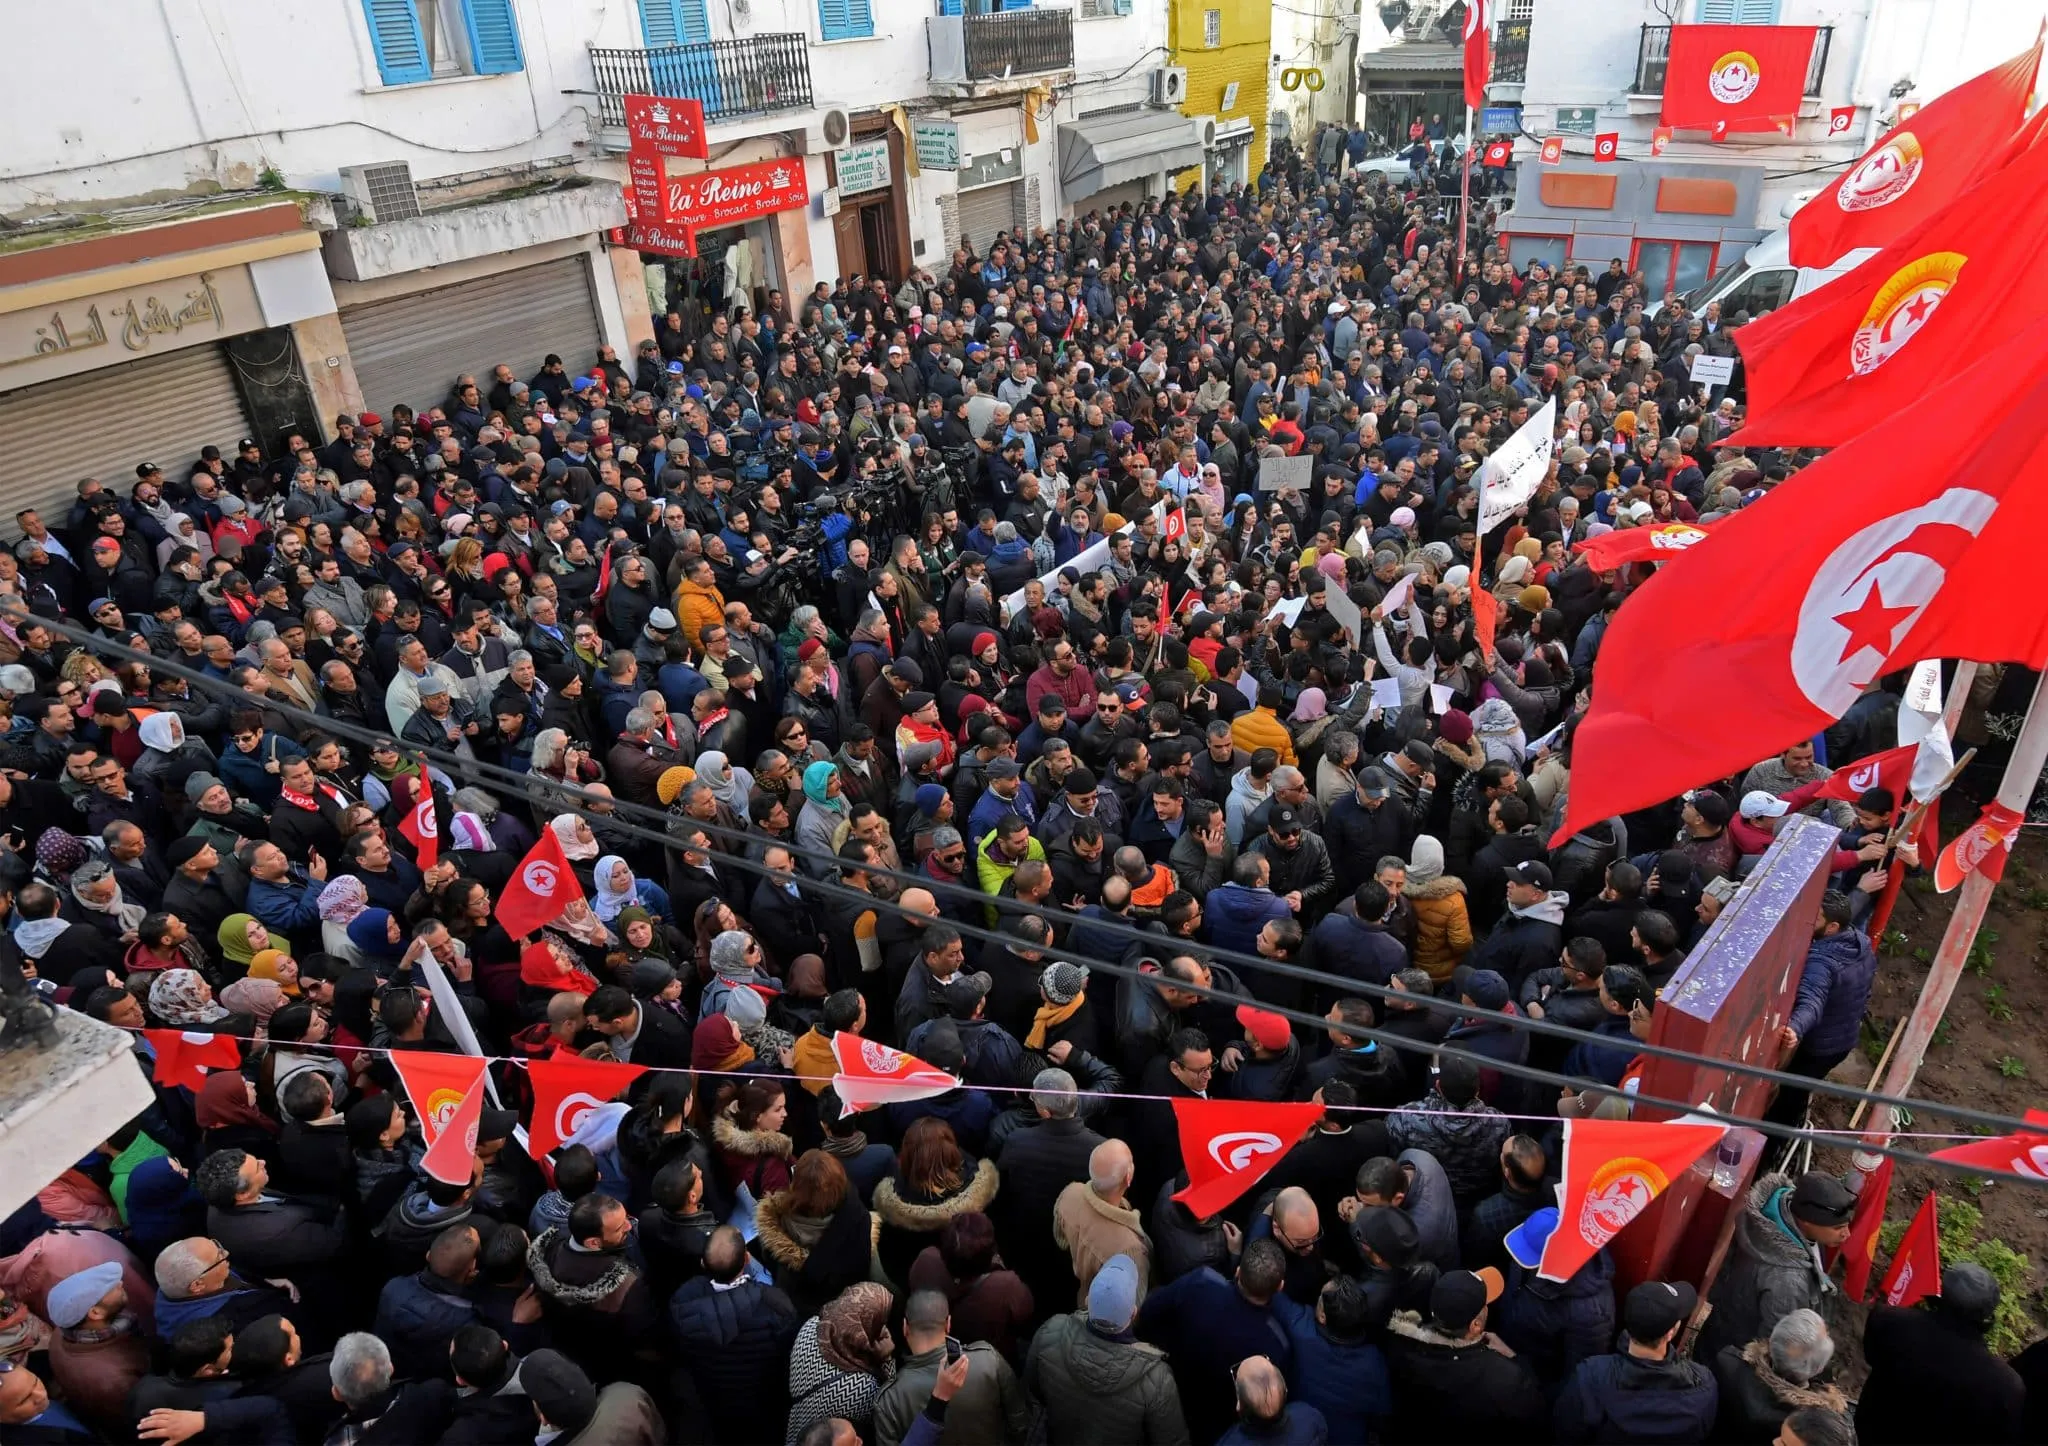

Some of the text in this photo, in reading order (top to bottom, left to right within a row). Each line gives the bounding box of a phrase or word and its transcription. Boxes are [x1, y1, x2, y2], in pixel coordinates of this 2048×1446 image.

[656, 125, 690, 143] Reine
[699, 176, 763, 206] Reine
[713, 203, 749, 219] Brocart
[755, 196, 781, 211] Brodé
[788, 192, 805, 204] Soie
[647, 227, 686, 250] Reine
